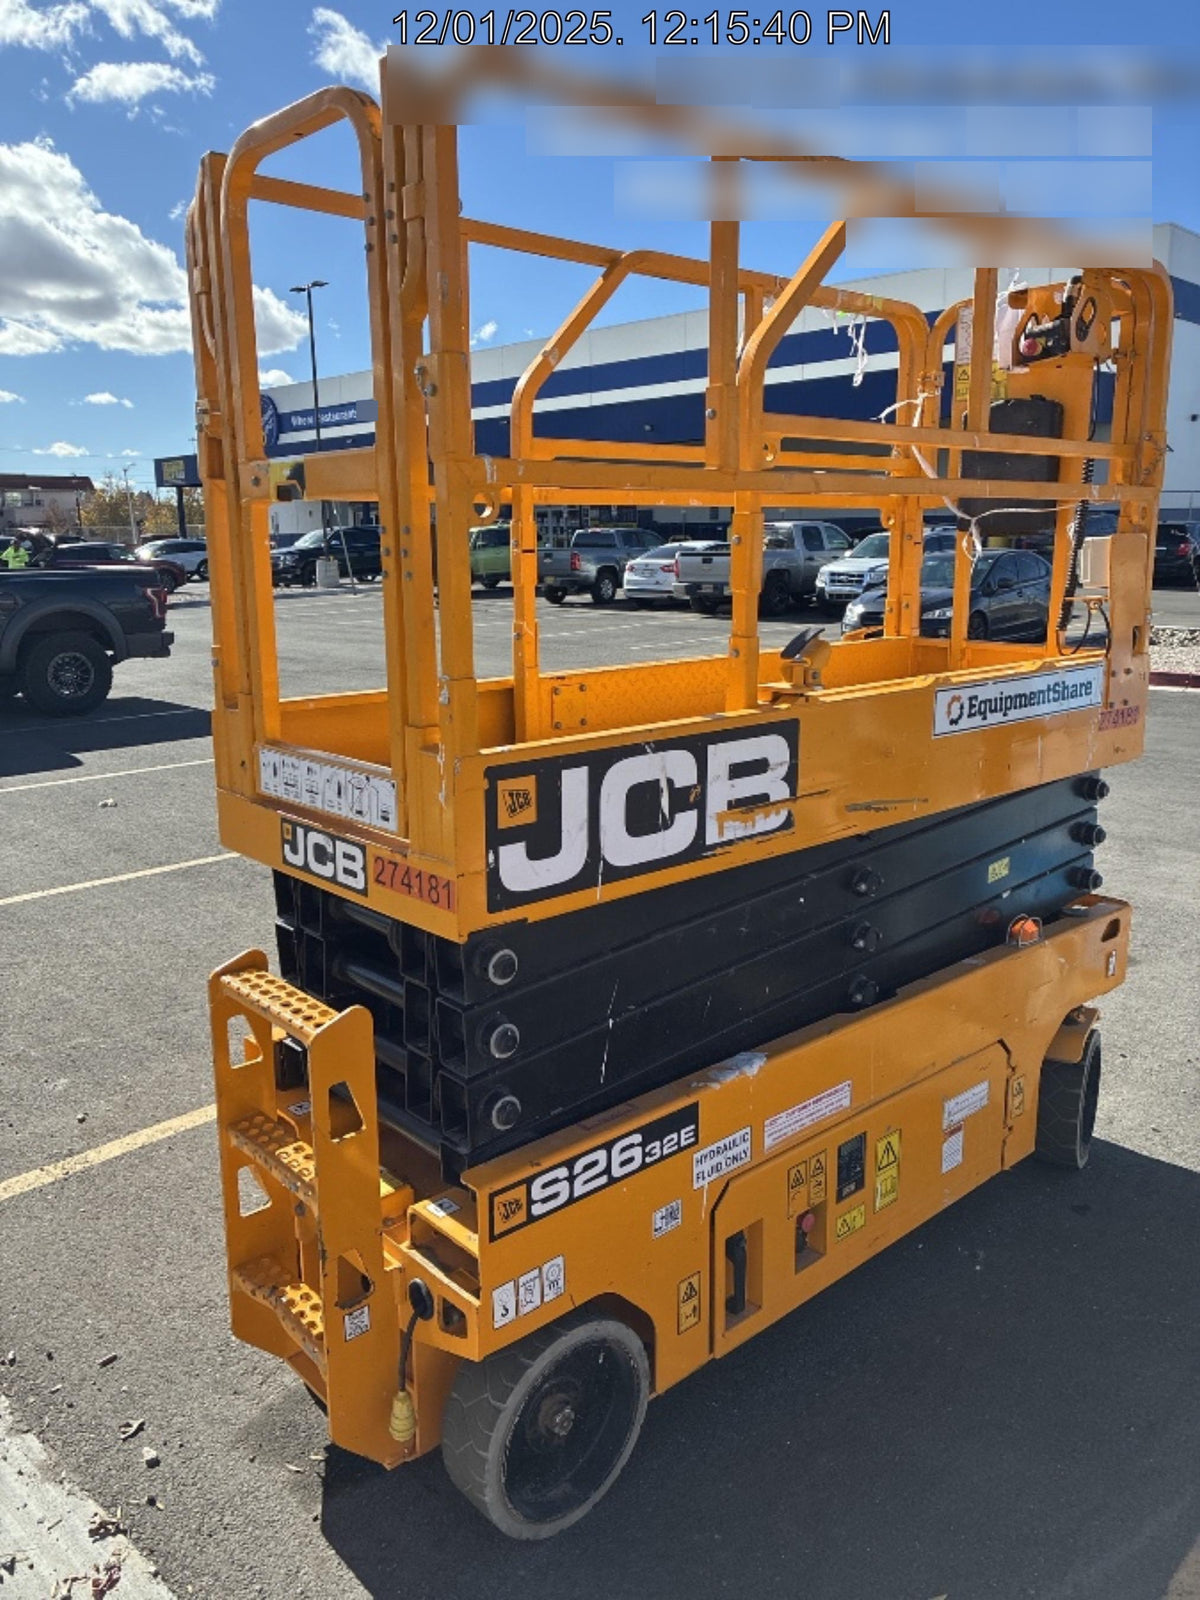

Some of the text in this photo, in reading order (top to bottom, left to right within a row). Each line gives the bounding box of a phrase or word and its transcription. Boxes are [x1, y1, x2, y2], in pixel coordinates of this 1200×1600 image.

[966, 679, 1093, 722] EquipmentShare
[499, 733, 792, 892] JCB
[283, 826, 366, 890] JCB
[373, 855, 452, 910] 274181
[695, 1131, 750, 1168] HYDRAULIC
[696, 1146, 749, 1184] FLUID ONLY
